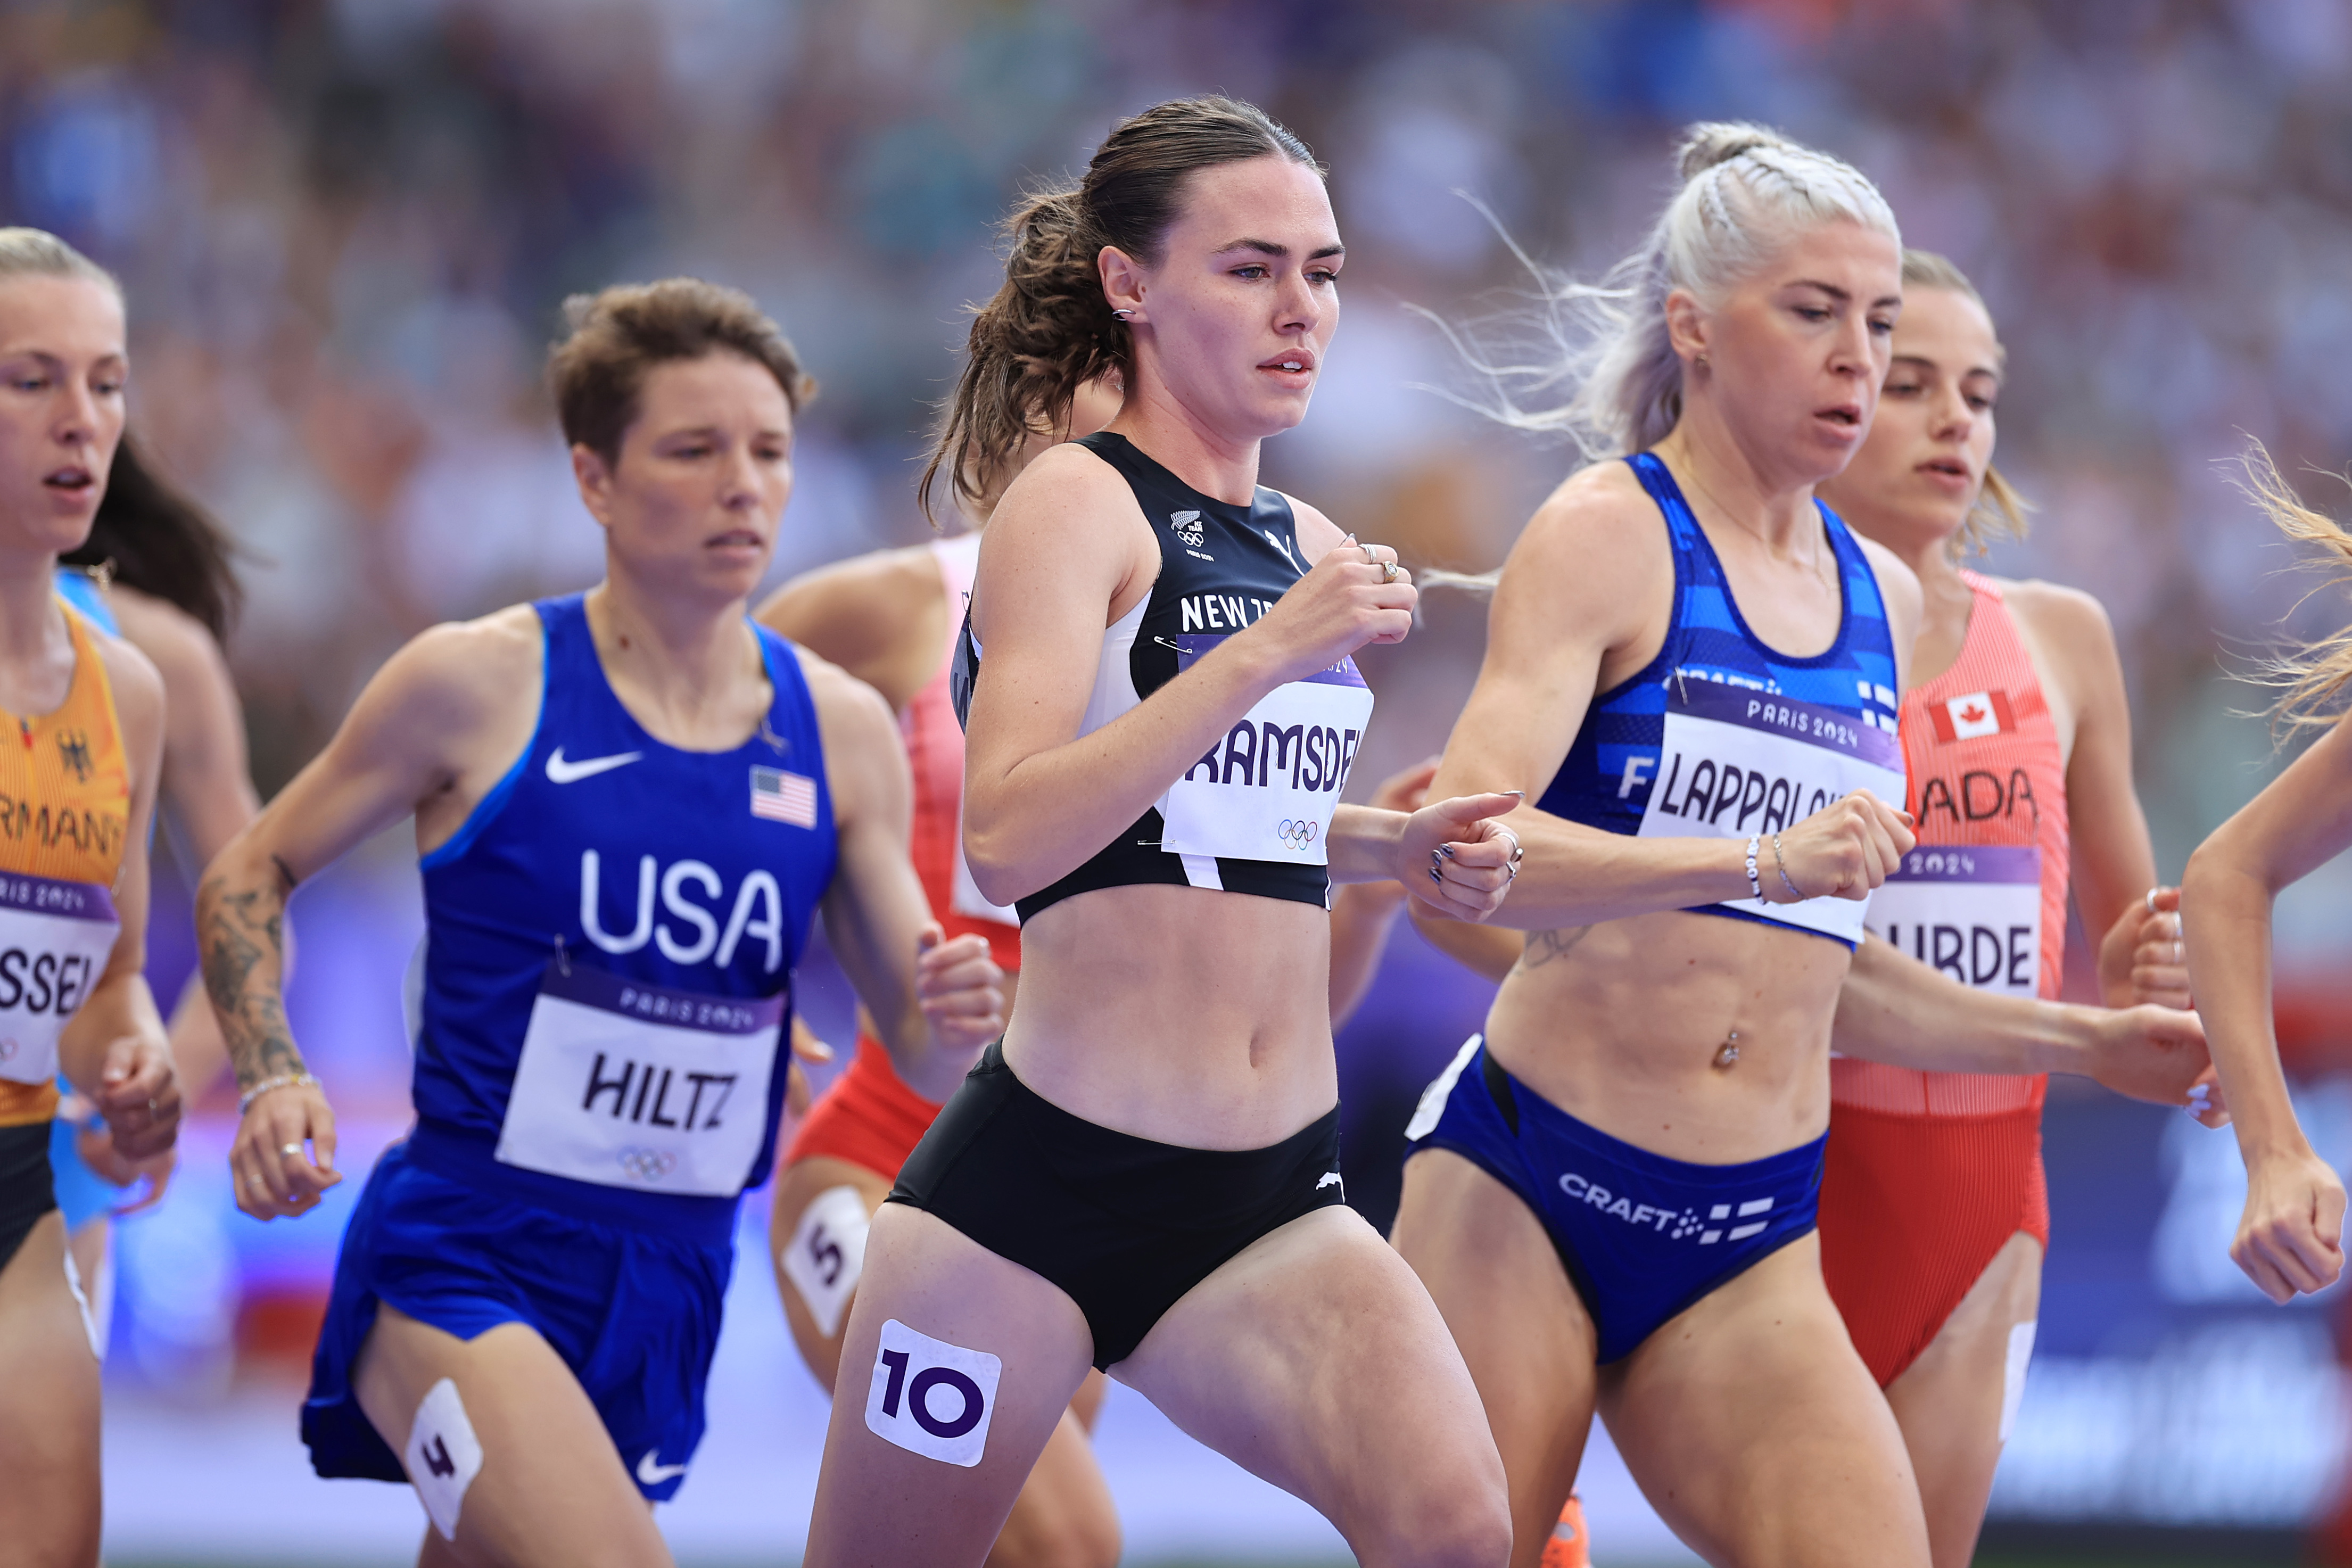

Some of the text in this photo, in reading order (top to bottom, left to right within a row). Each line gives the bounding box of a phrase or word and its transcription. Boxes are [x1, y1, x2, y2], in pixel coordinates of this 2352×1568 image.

[1181, 595, 1248, 632] NEW
[1747, 699, 1858, 748] PARIS 2024
[1919, 768, 2039, 828] ADA
[1909, 852, 1975, 876] 2024
[579, 848, 783, 976] USA
[619, 987, 694, 1022] PARIS
[583, 1050, 738, 1130] HILTZ
[1558, 1172, 1678, 1232] CRAFT
[808, 1223, 844, 1287] 5
[881, 1348, 985, 1439] 10
